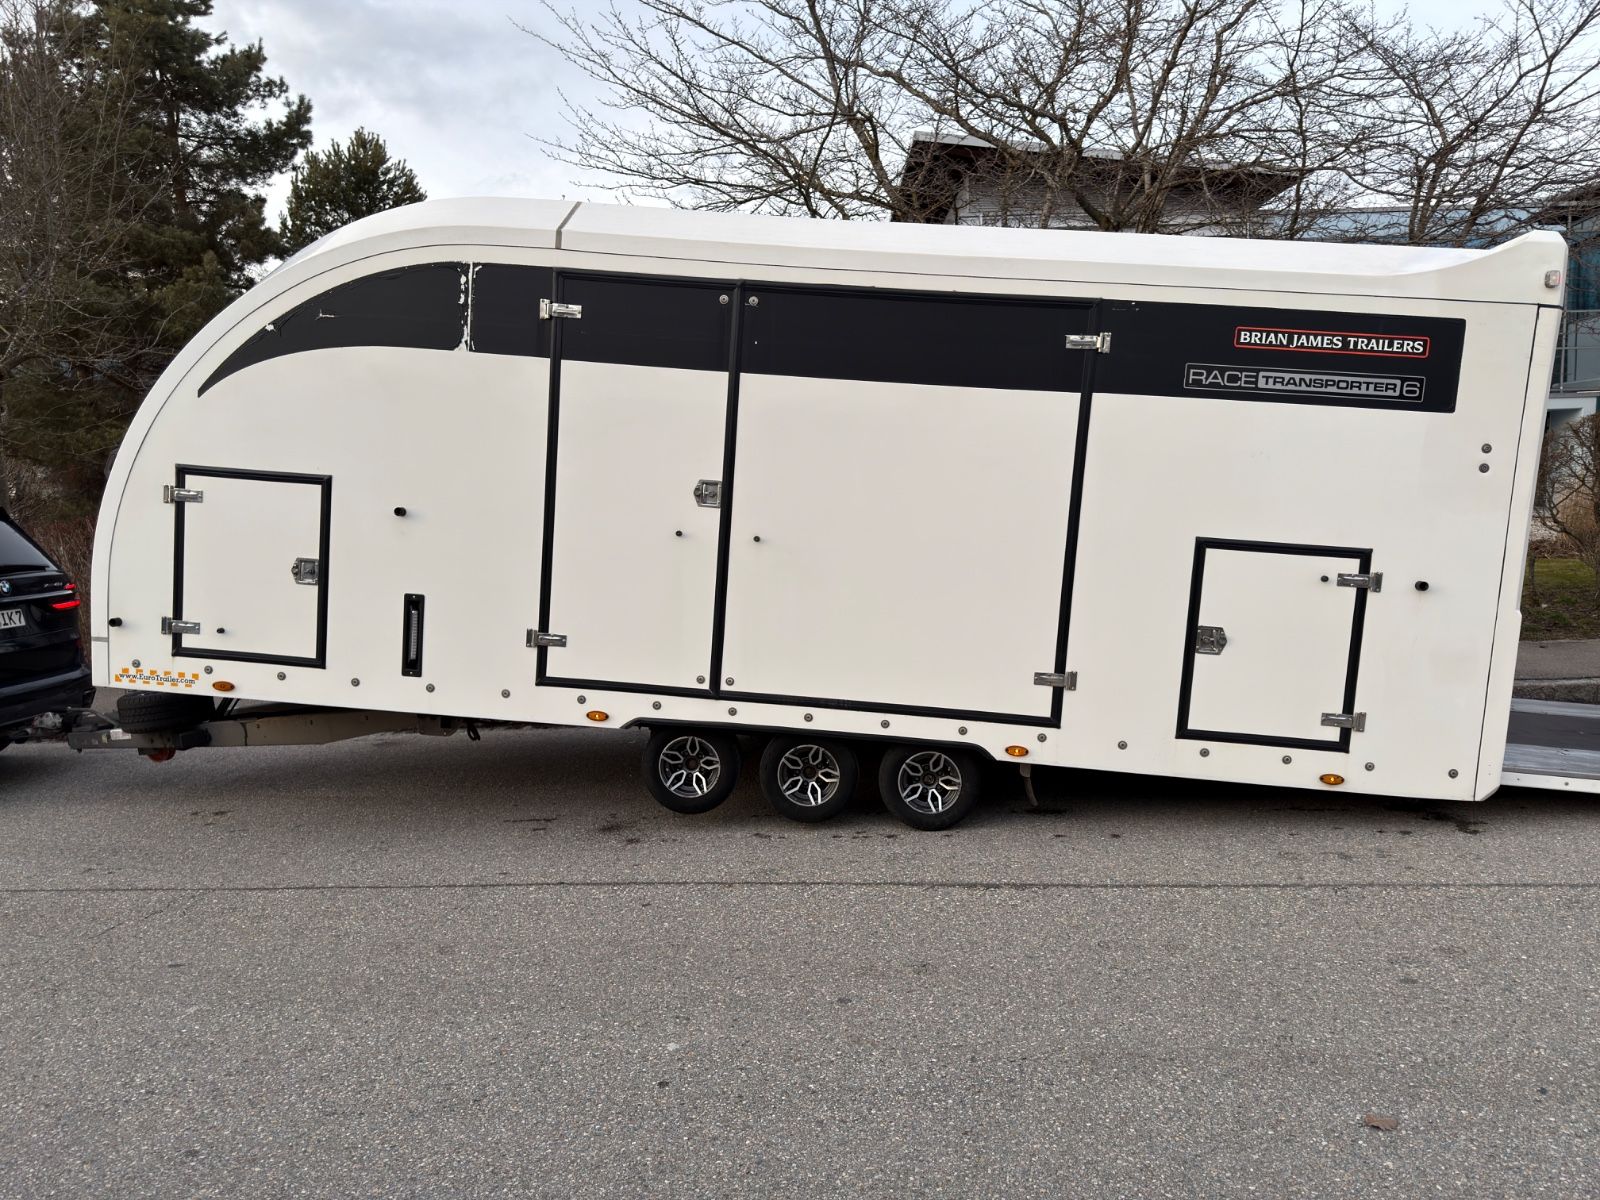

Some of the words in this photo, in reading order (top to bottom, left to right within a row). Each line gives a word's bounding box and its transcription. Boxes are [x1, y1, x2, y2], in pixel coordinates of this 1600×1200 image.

[1239, 331, 1288, 345] BRIAN
[1289, 334, 1343, 349] JAMES
[1347, 337, 1425, 353] TRAILERS
[1188, 368, 1257, 387] RACE
[1261, 374, 1398, 393] TRANSPORTER
[1402, 381, 1420, 397] 6
[118, 673, 196, 684] www.EuroTrailer.com
